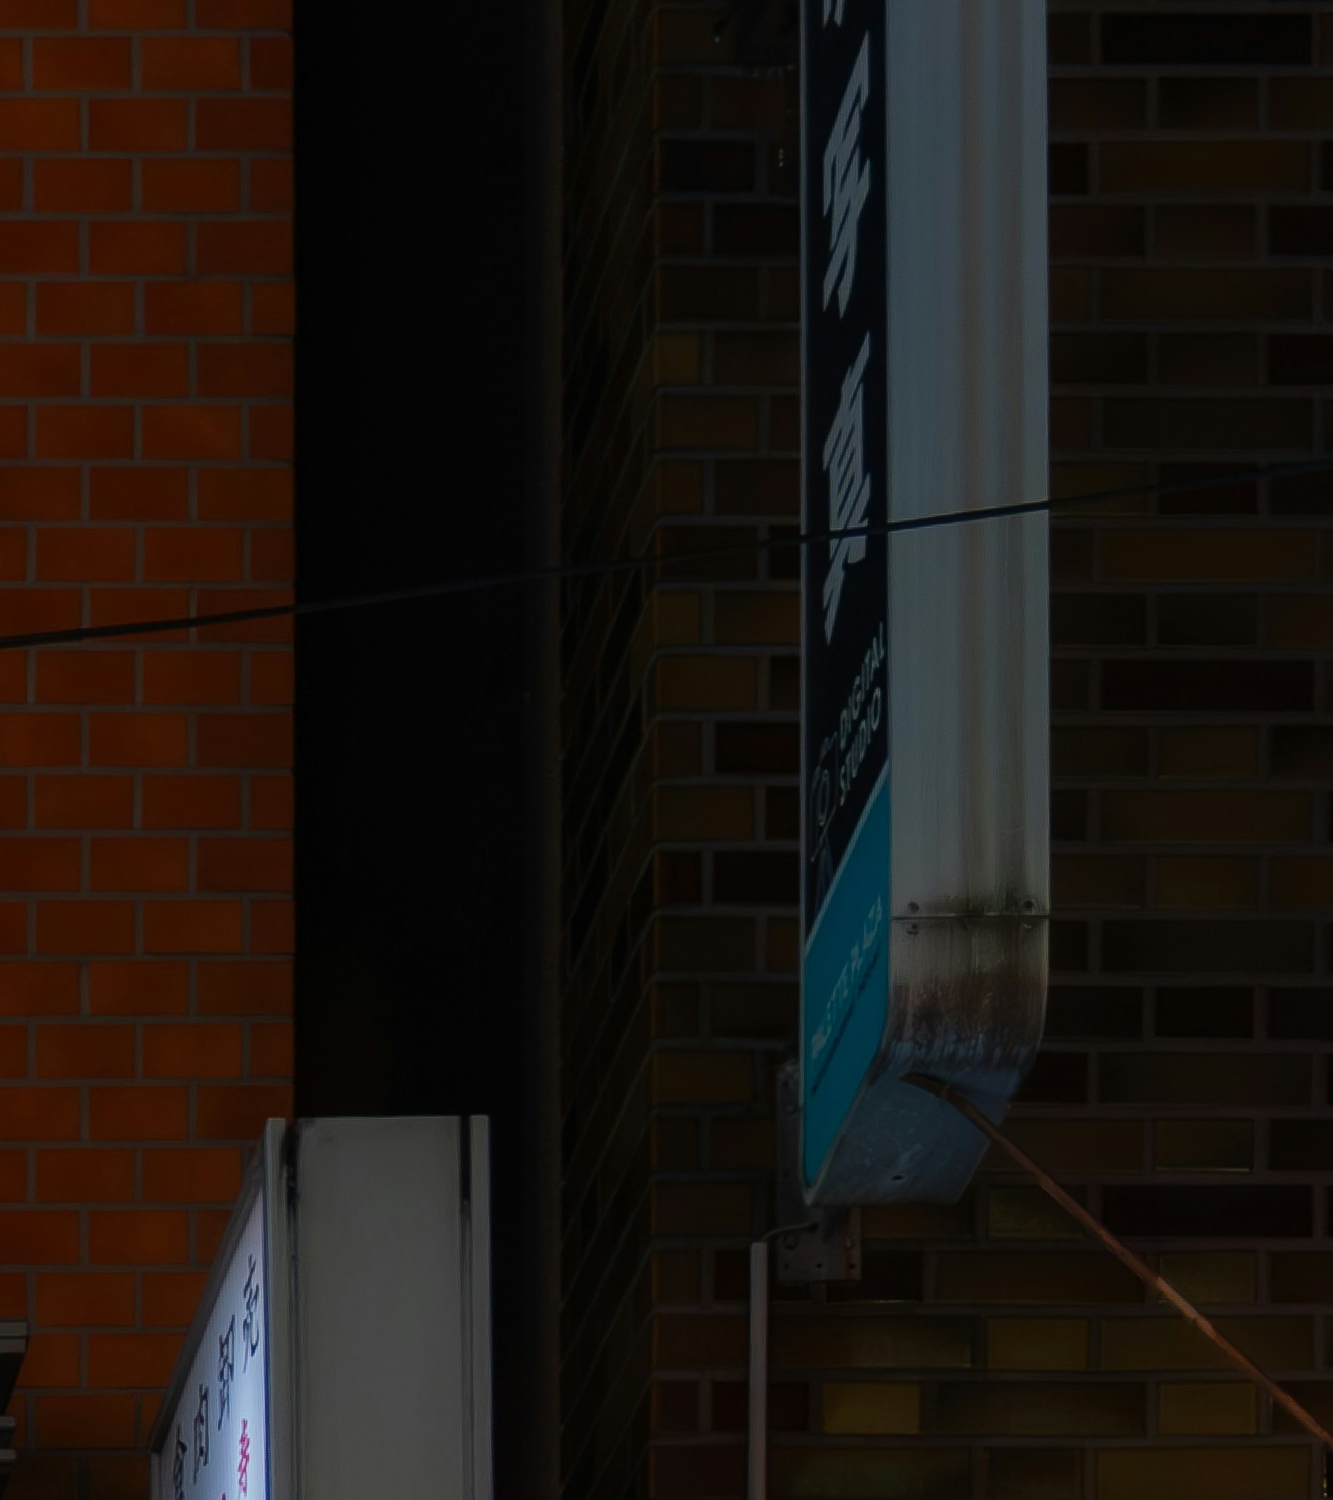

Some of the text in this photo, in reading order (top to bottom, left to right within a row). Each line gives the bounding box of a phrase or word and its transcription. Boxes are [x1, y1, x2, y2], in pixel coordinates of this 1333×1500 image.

[821, 0, 874, 647] 写真
[838, 620, 887, 745] DIGITAL
[838, 686, 883, 807] STUDIO
